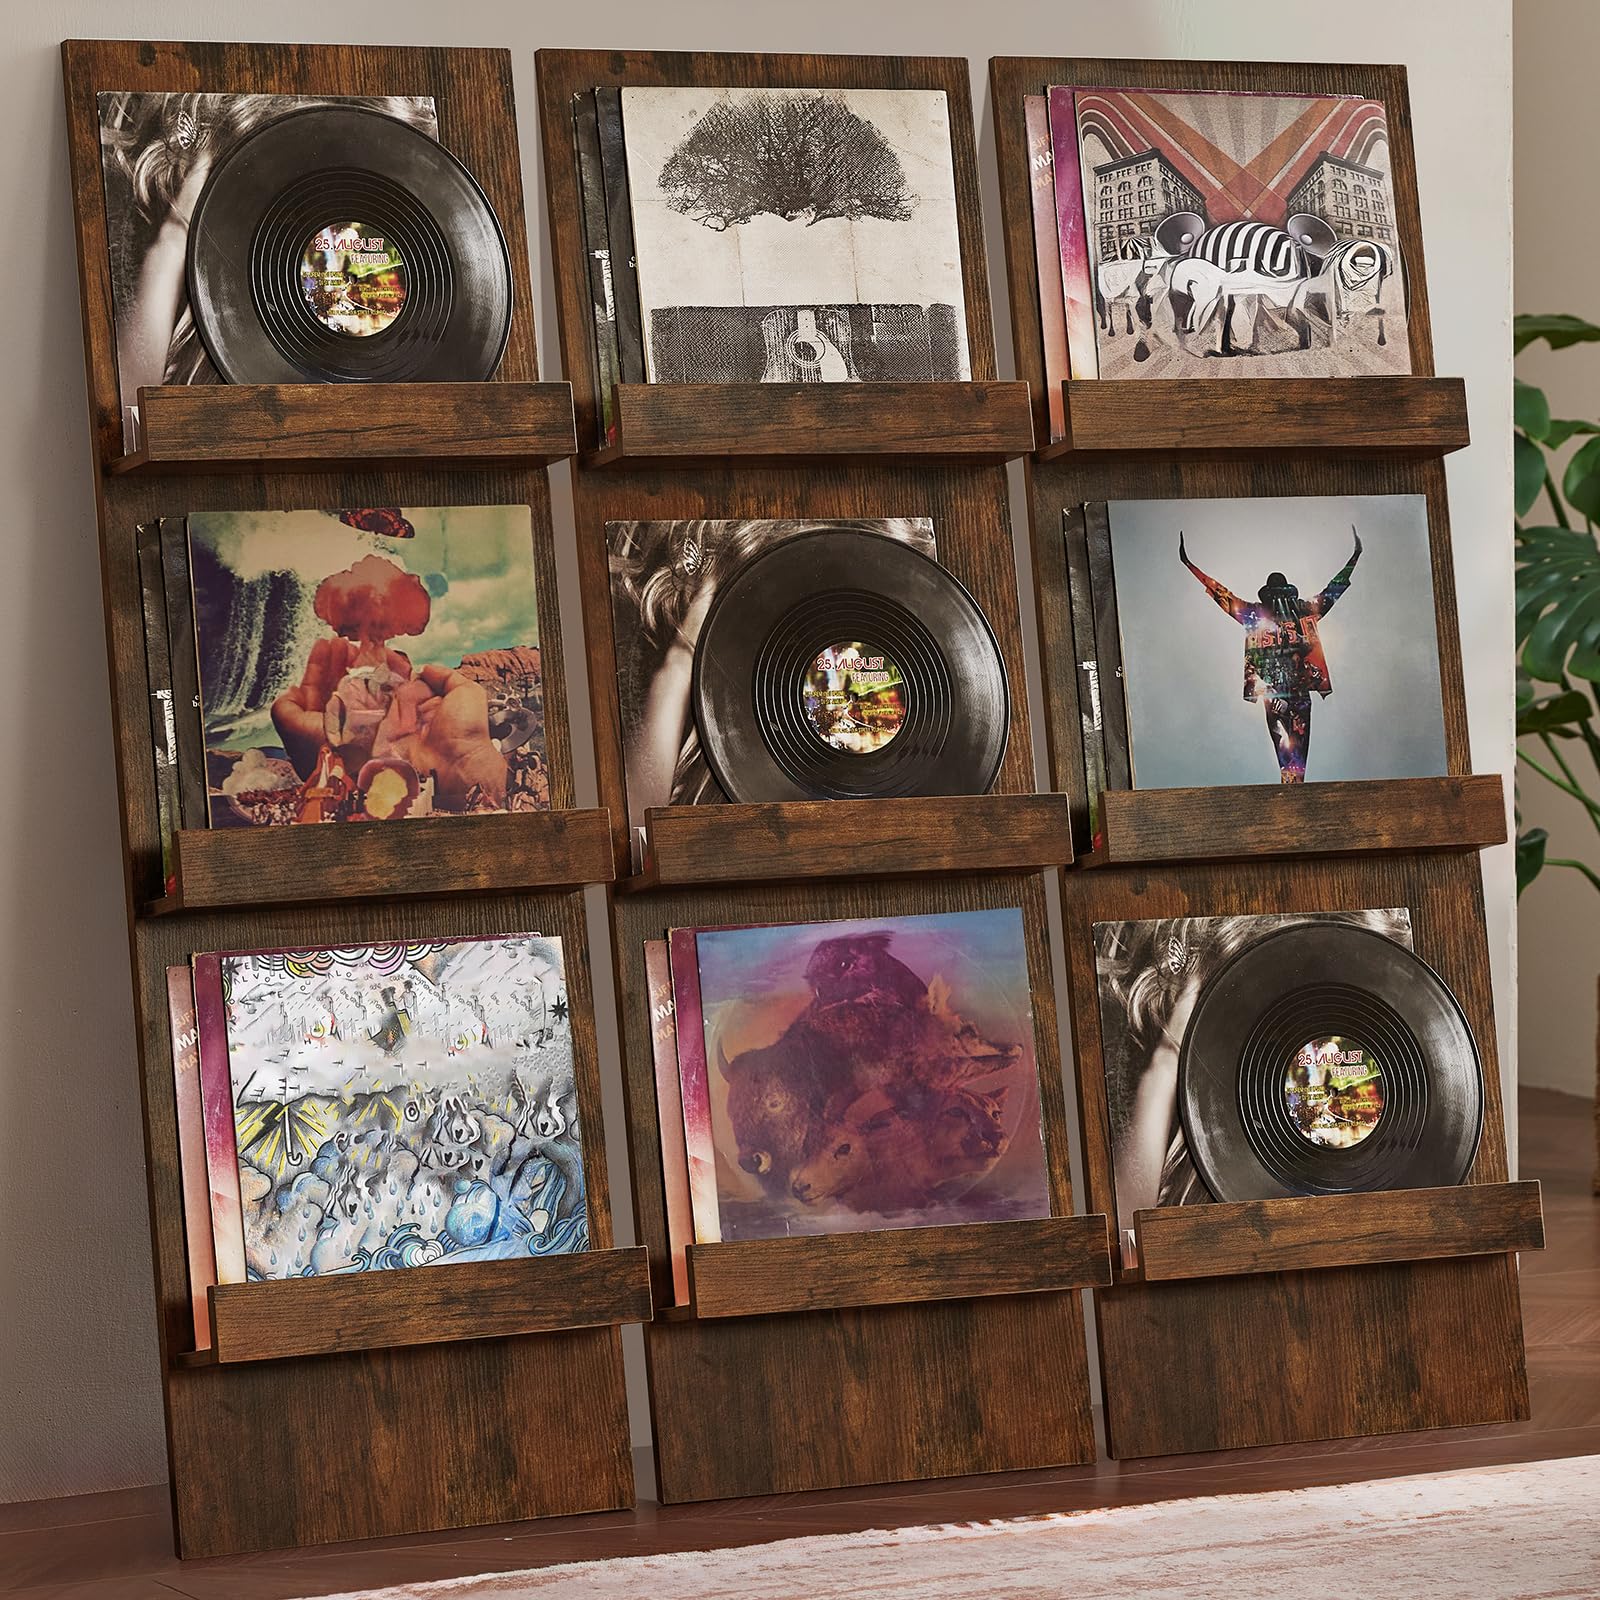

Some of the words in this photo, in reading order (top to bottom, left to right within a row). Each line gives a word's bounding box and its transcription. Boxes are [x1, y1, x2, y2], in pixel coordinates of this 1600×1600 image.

[334, 237, 384, 252] AUGUST
[350, 253, 389, 265] FEATURING
[836, 656, 884, 671] AUGUST
[851, 671, 889, 683] FEATURING
[1316, 1050, 1363, 1066] AUGUST
[1331, 1065, 1368, 1078] FEATURING
